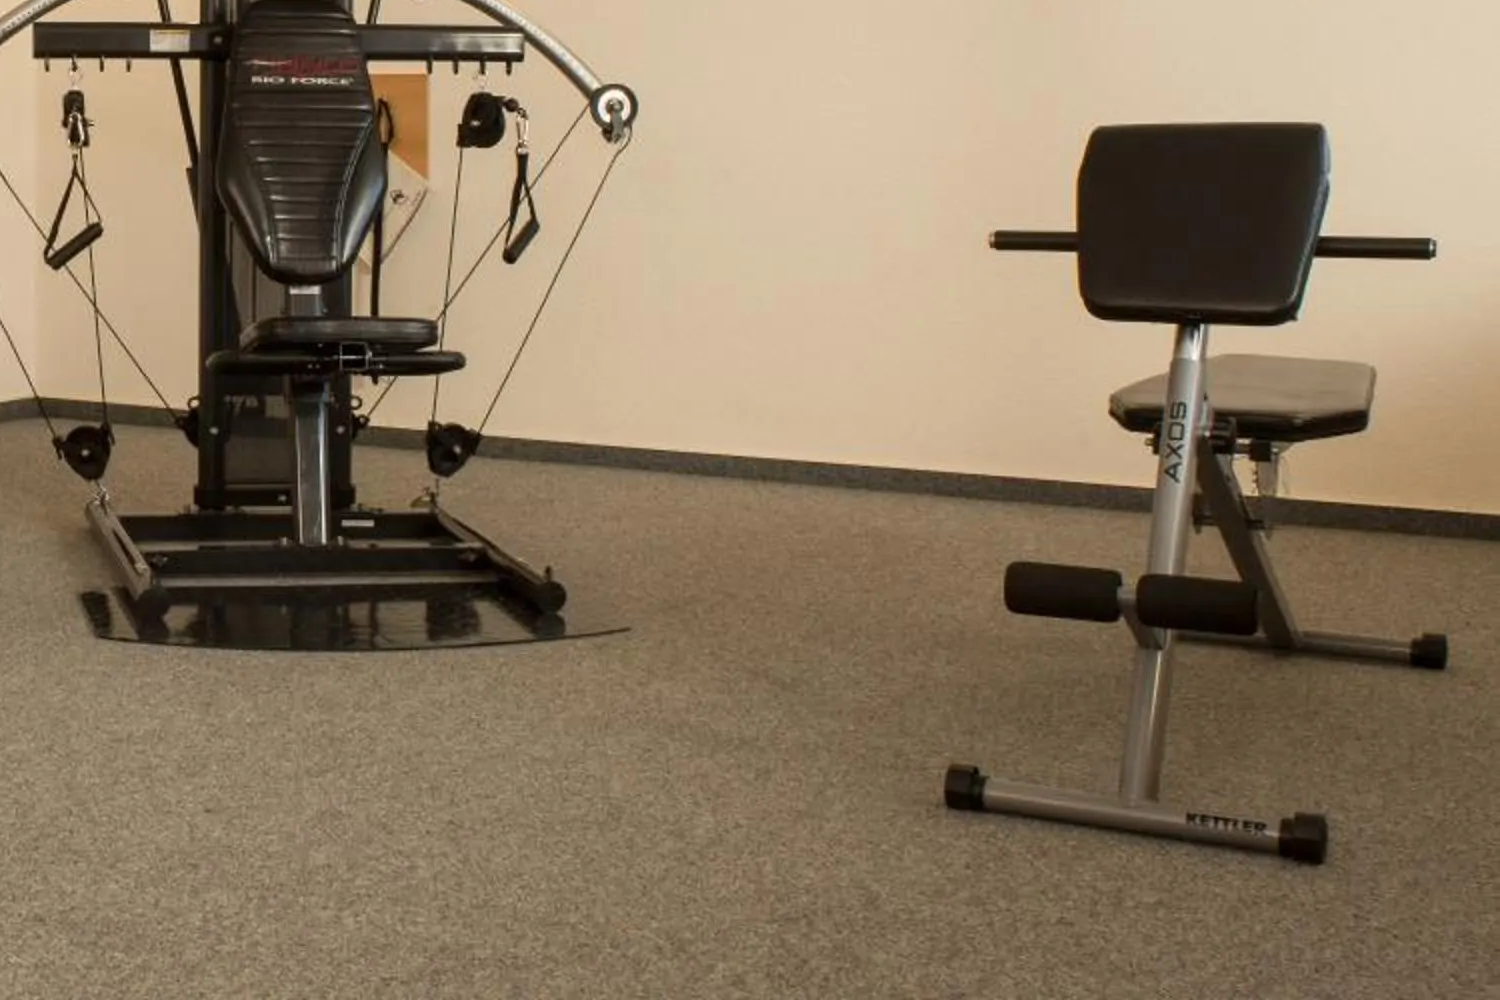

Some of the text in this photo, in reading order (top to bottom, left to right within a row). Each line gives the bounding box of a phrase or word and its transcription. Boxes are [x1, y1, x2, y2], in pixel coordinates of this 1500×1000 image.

[251, 75, 350, 86] BIO FORCE
[1163, 400, 1188, 484] AXOS
[1185, 811, 1268, 836] KETTLER
